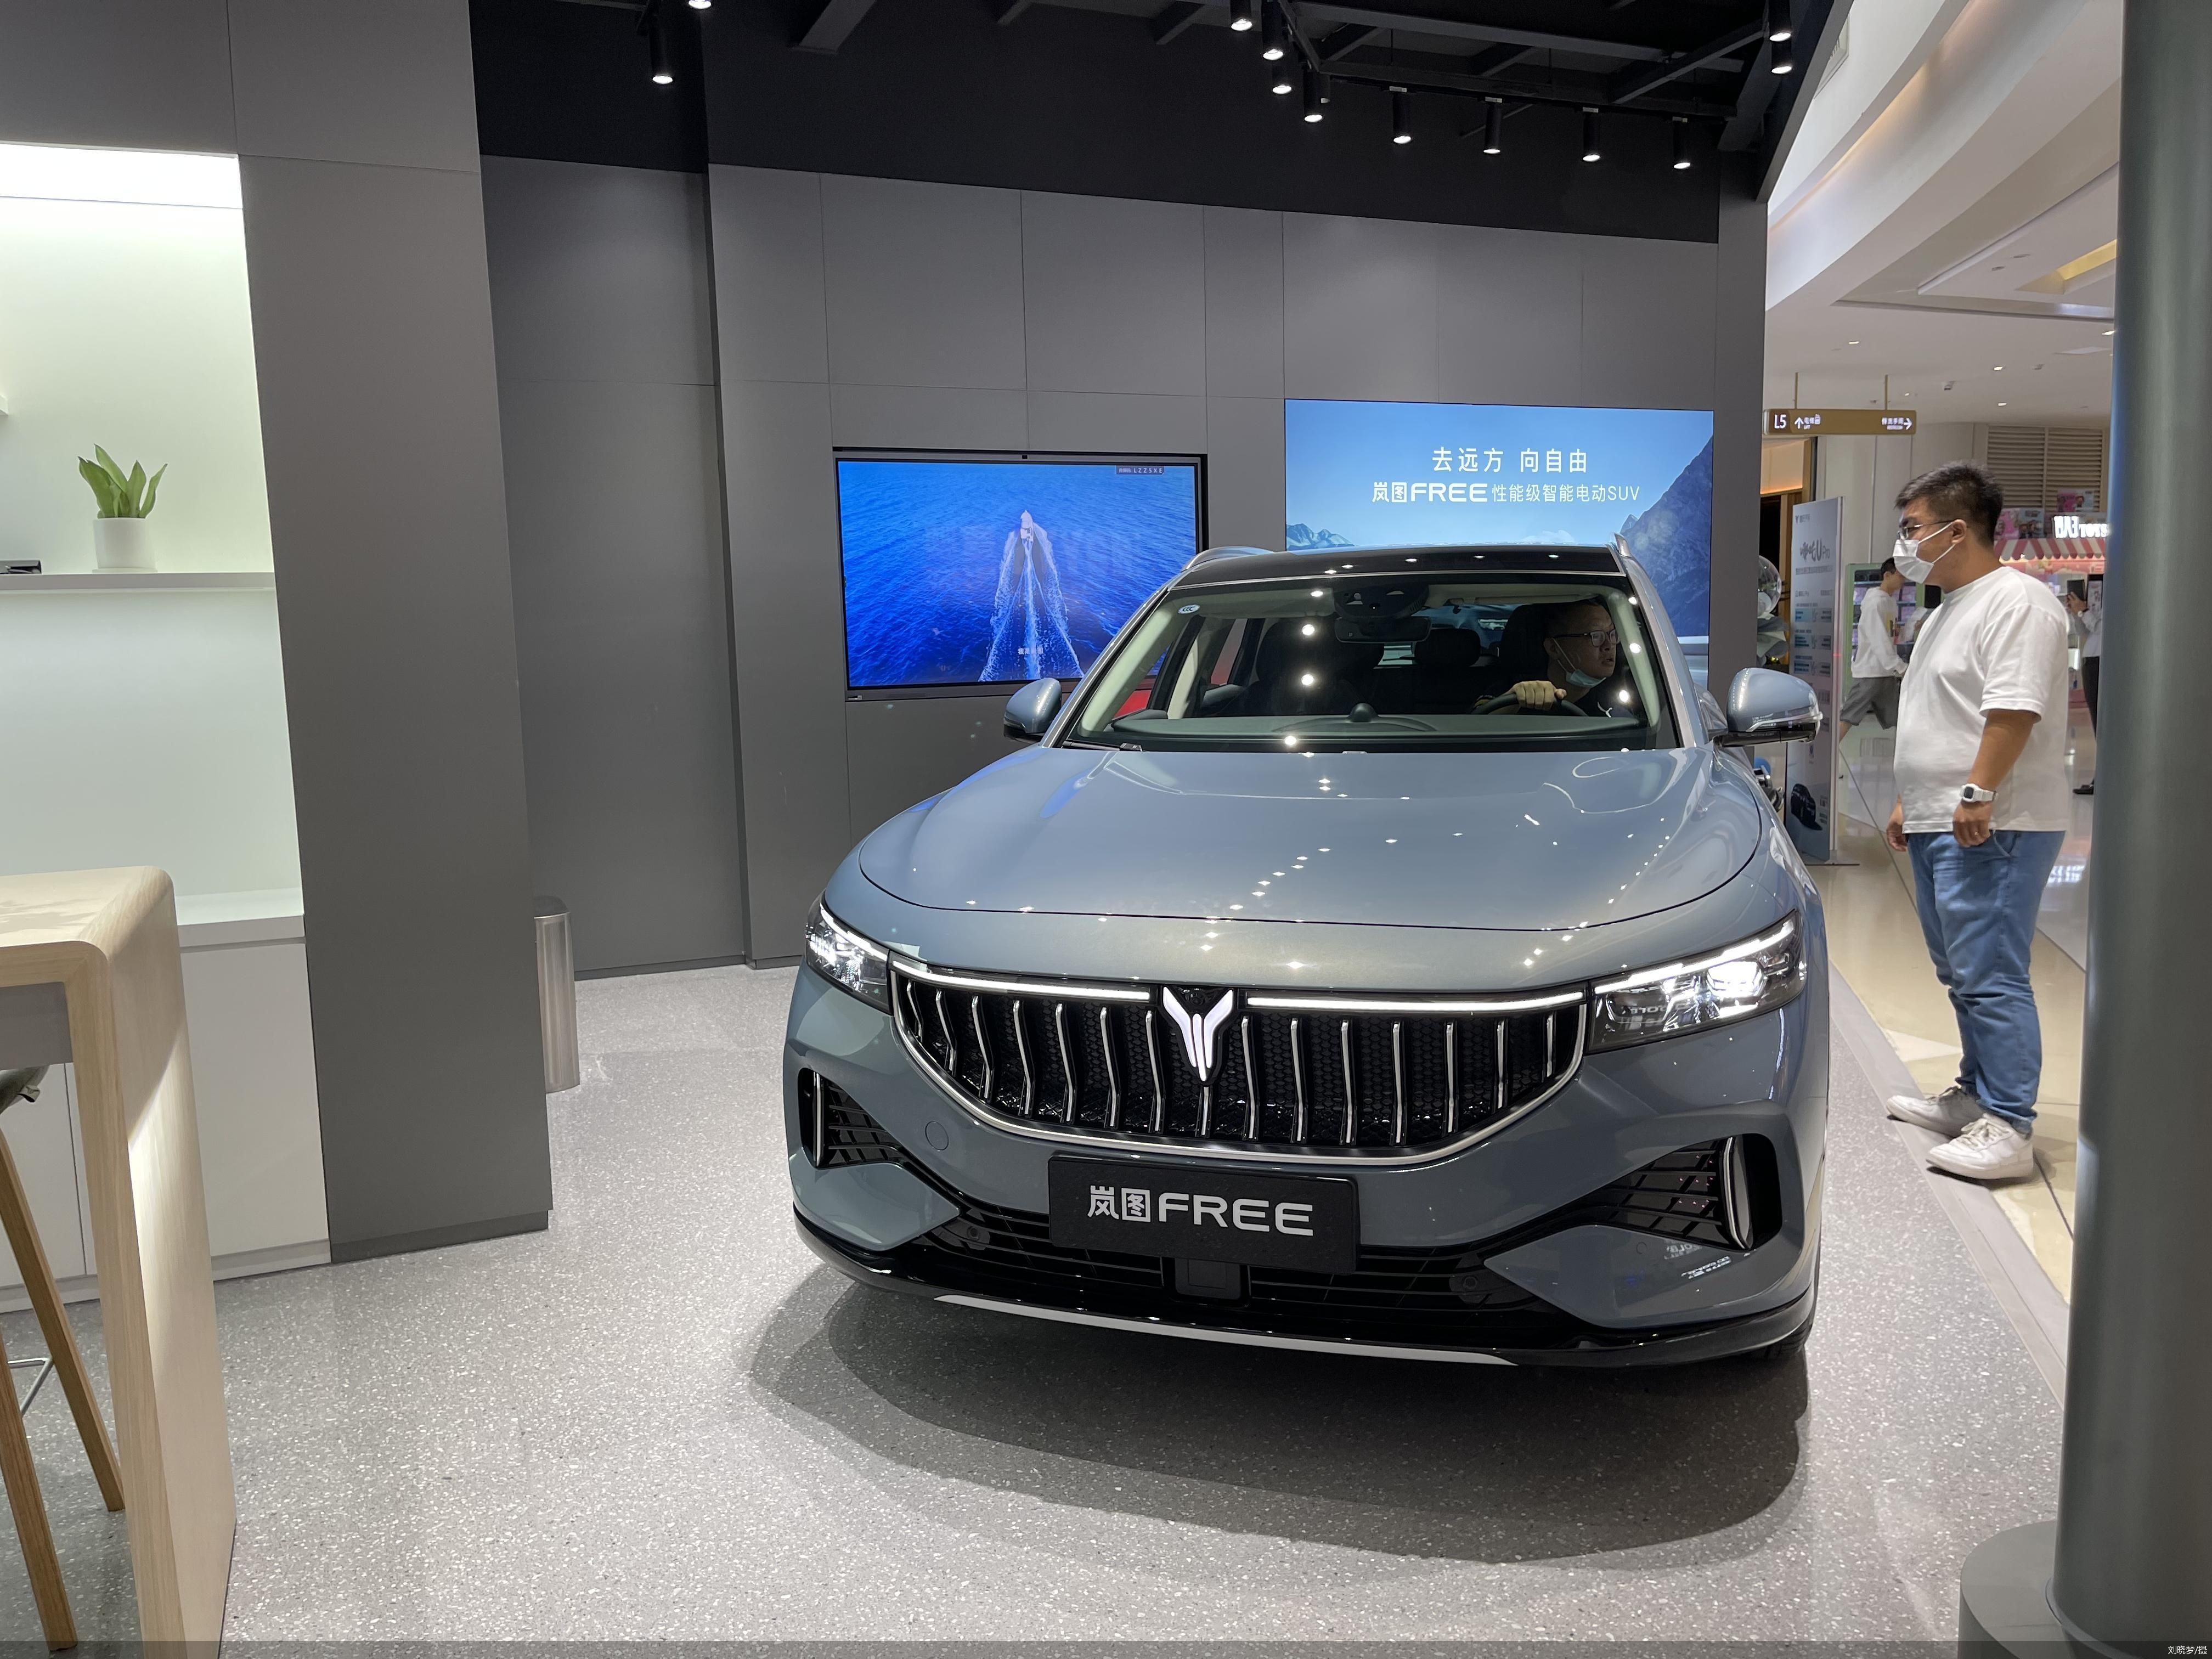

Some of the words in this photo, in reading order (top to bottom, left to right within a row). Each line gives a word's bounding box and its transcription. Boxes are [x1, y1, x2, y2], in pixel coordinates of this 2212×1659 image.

[1774, 414, 1786, 429] L5
[1432, 446, 1504, 473] 去远方
[1520, 447, 1587, 473] 向自由
[1372, 481, 1488, 503] 岚图FREE
[1492, 483, 1640, 503] 性能级智能电动SUV
[1087, 1184, 1313, 1237] 岚图FREE
